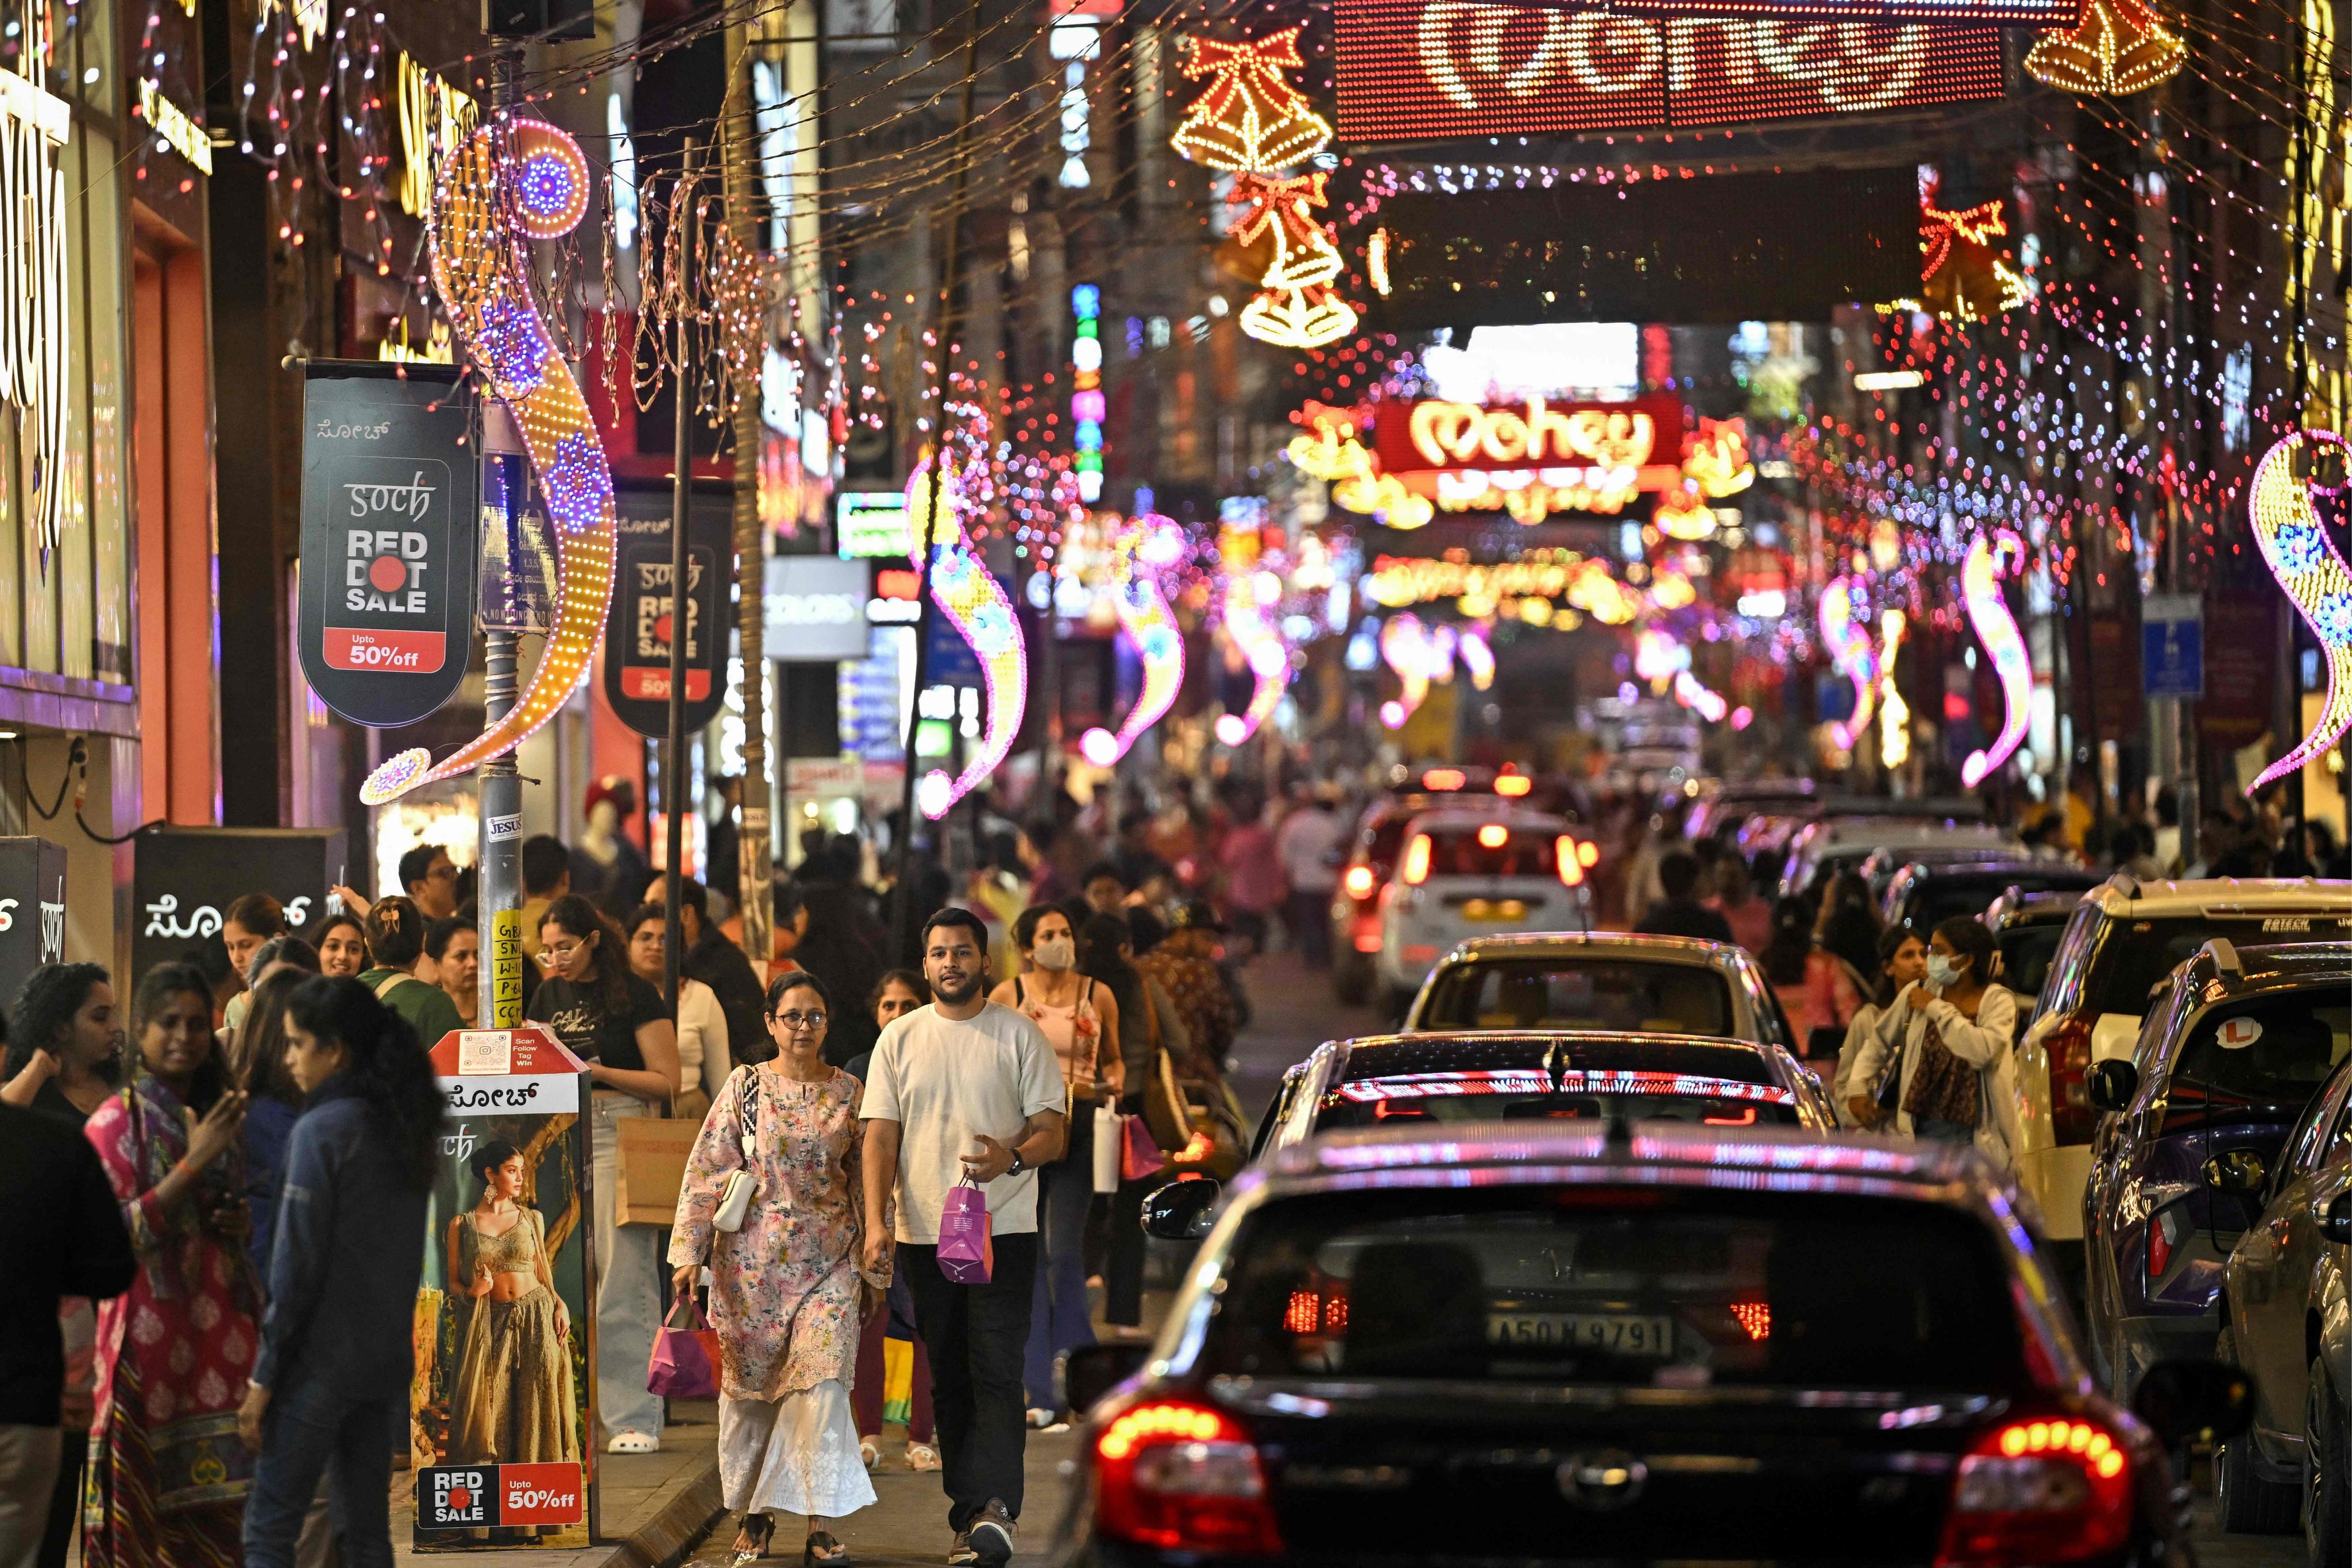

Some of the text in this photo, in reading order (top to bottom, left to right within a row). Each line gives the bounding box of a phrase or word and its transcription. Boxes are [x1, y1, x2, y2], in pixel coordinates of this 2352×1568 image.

[317, 419, 391, 439] ಸೋಚ್
[1410, 393, 1655, 470] Mohey
[347, 530, 428, 559] RED
[346, 588, 426, 613] SALE
[352, 635, 375, 644] Upto
[491, 820, 522, 834] JESUS
[2226, 1022, 2253, 1043] L
[434, 1472, 483, 1490] RED
[509, 1481, 531, 1489] Upto
[435, 1507, 484, 1522] SALE
